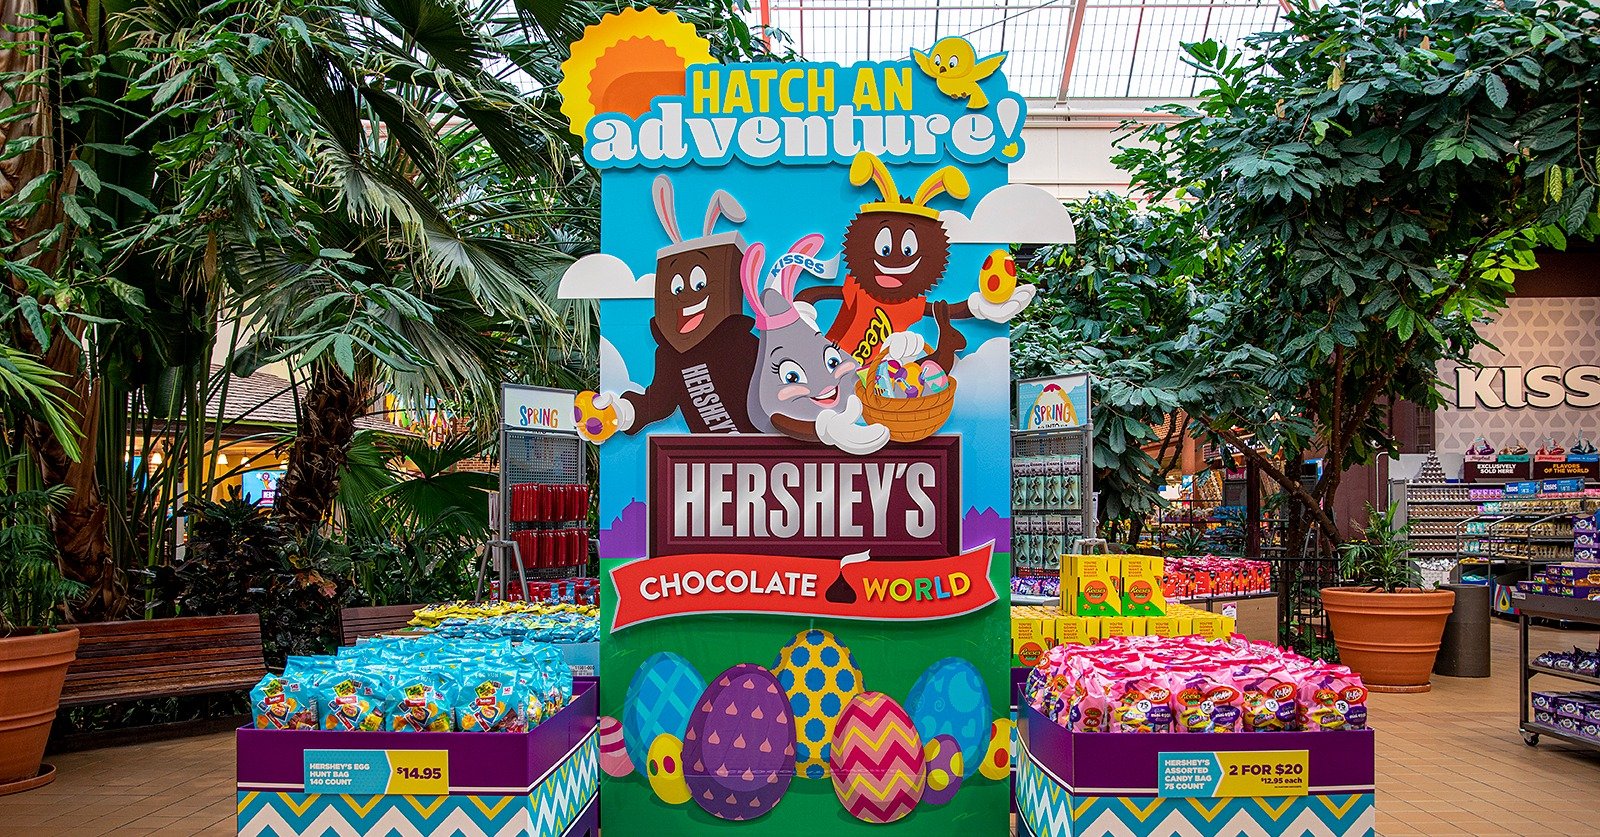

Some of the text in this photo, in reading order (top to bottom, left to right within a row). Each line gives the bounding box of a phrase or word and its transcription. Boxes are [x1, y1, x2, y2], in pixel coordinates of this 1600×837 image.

[692, 67, 913, 114] HATCH AN
[590, 98, 1019, 161] adventure!
[681, 363, 740, 435] HERSHEY'
[519, 405, 559, 429] SPRING
[1034, 402, 1071, 426] SPRING
[673, 461, 937, 538] HERSHEY'S
[639, 569, 972, 602] CHOCOLATE WORLD
[1203, 702, 1212, 710] 75
[397, 766, 442, 780] $14.95
[1229, 763, 1303, 776] 2 FOR $20
